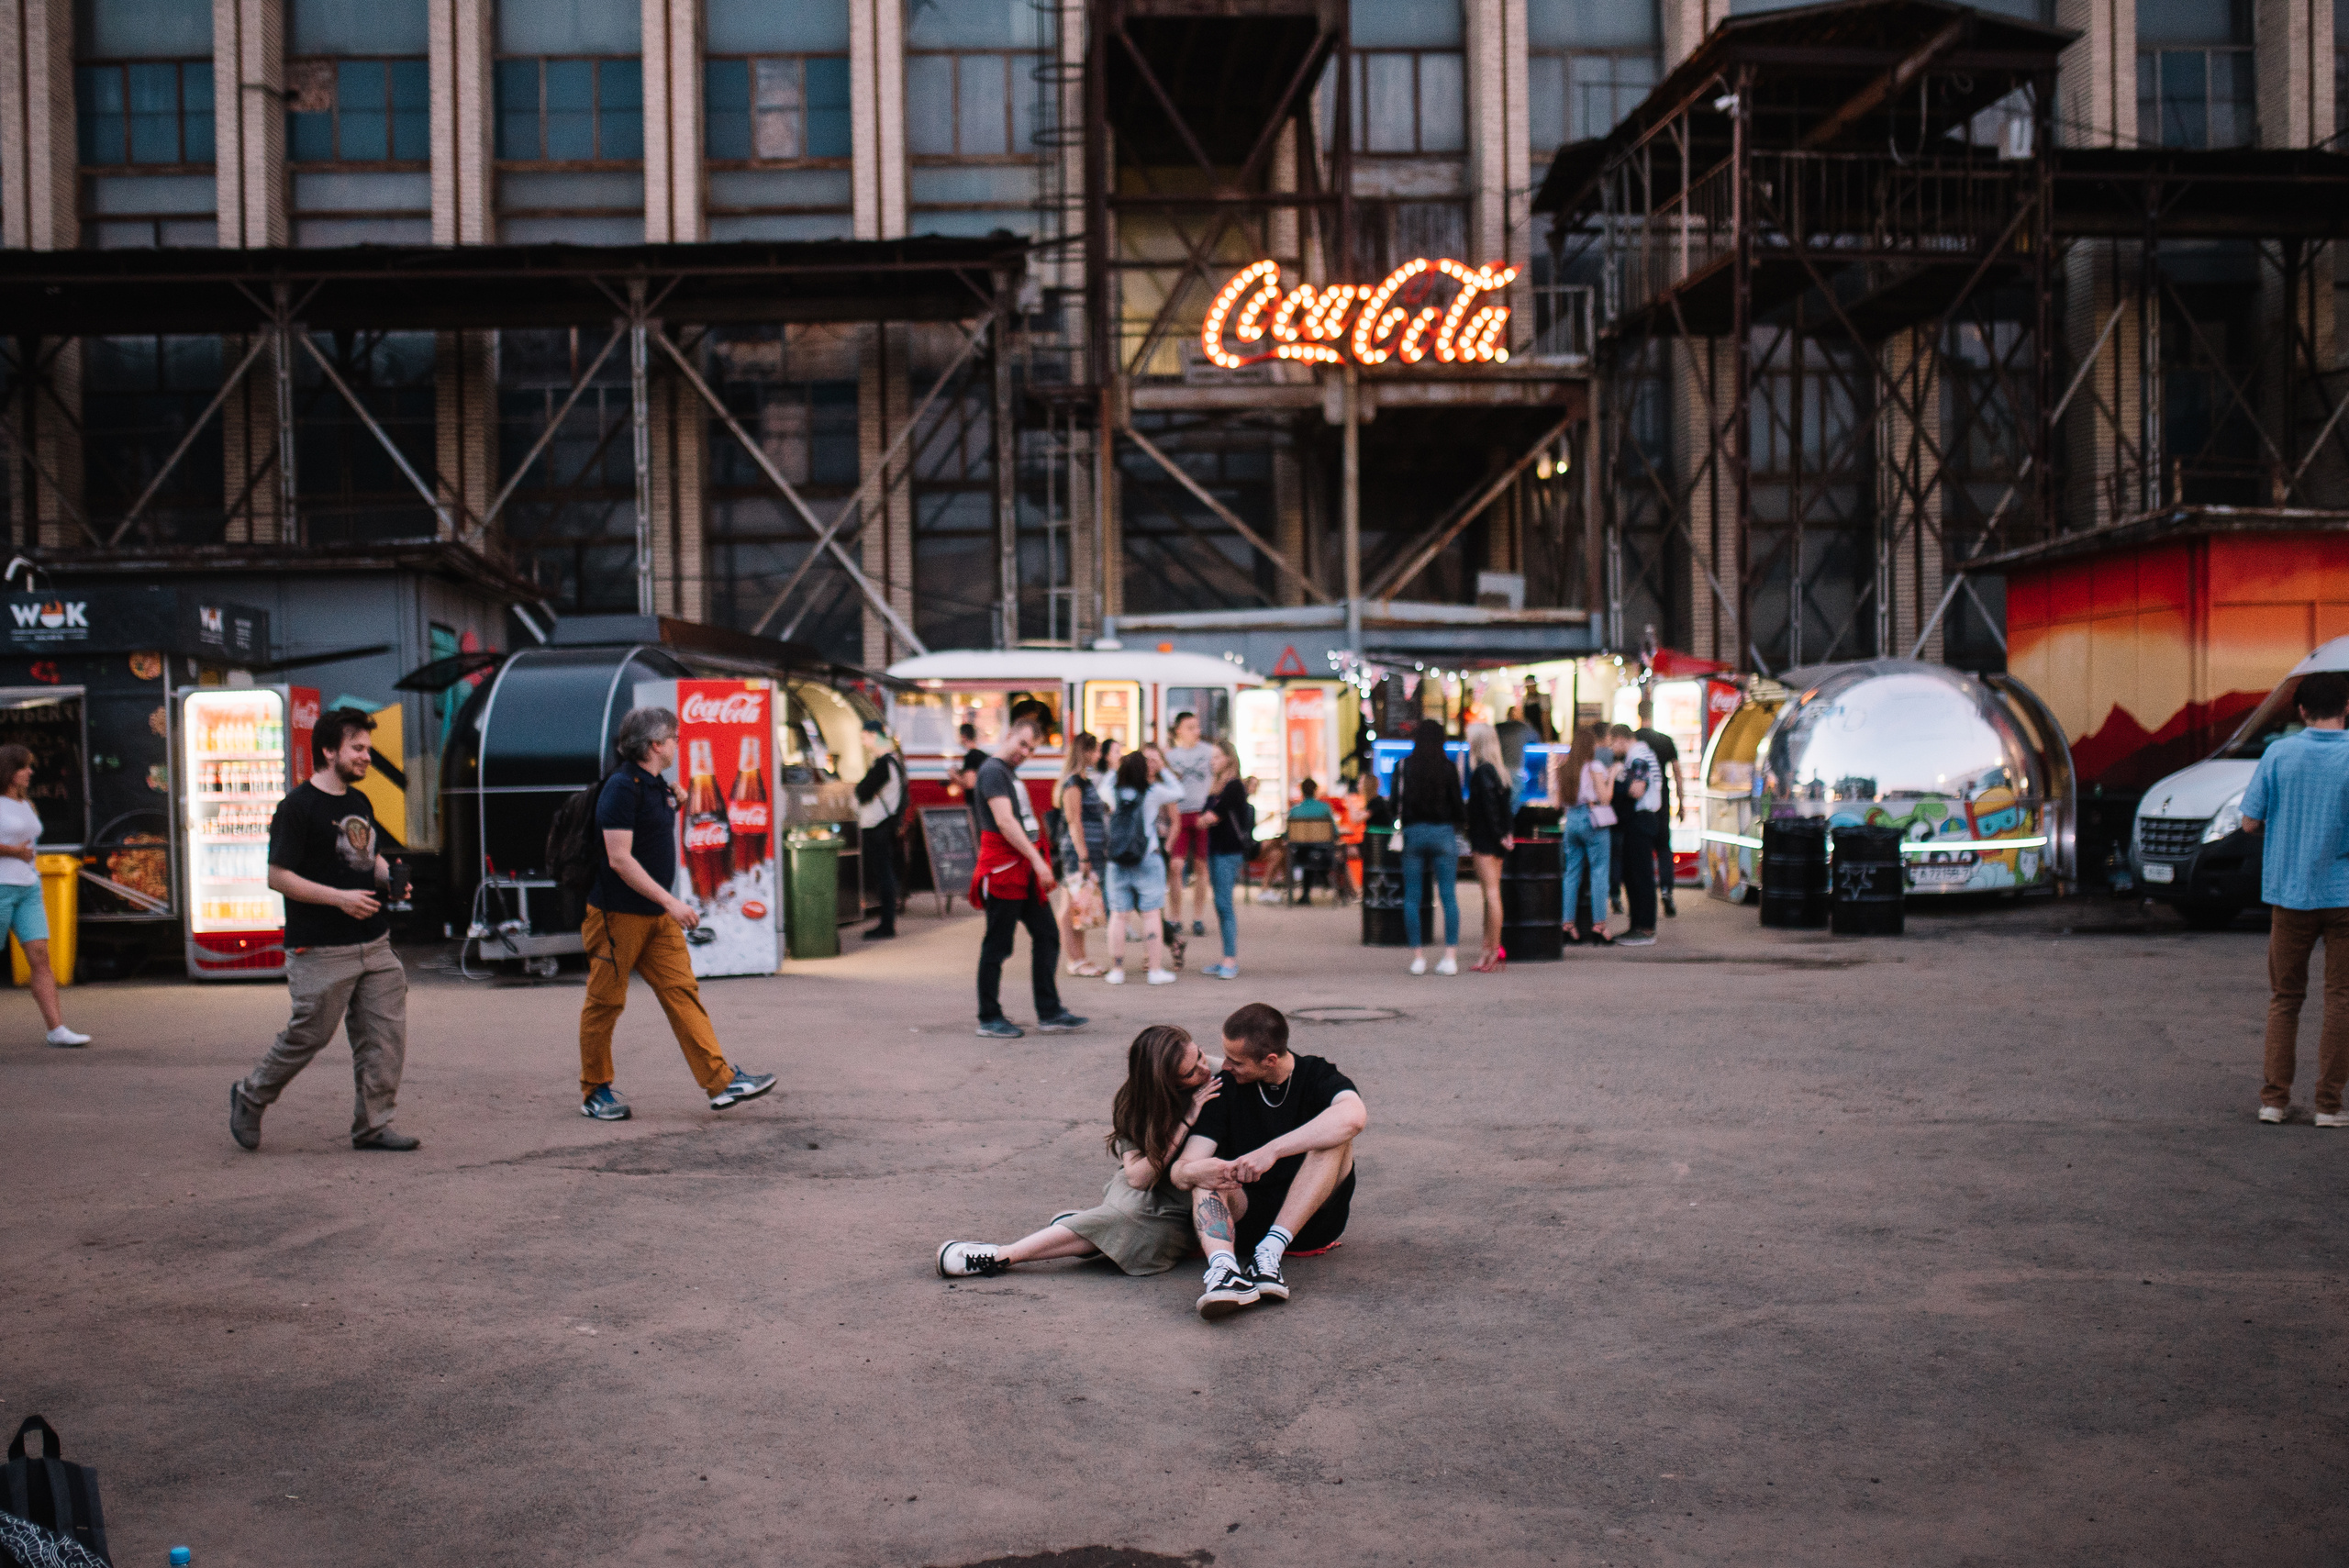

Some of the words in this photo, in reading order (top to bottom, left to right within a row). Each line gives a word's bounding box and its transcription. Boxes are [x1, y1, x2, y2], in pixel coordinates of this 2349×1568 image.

[1201, 258, 1524, 369] Coca-Cola
[9, 600, 89, 628] WOK
[681, 692, 765, 724] Coca-Cola
